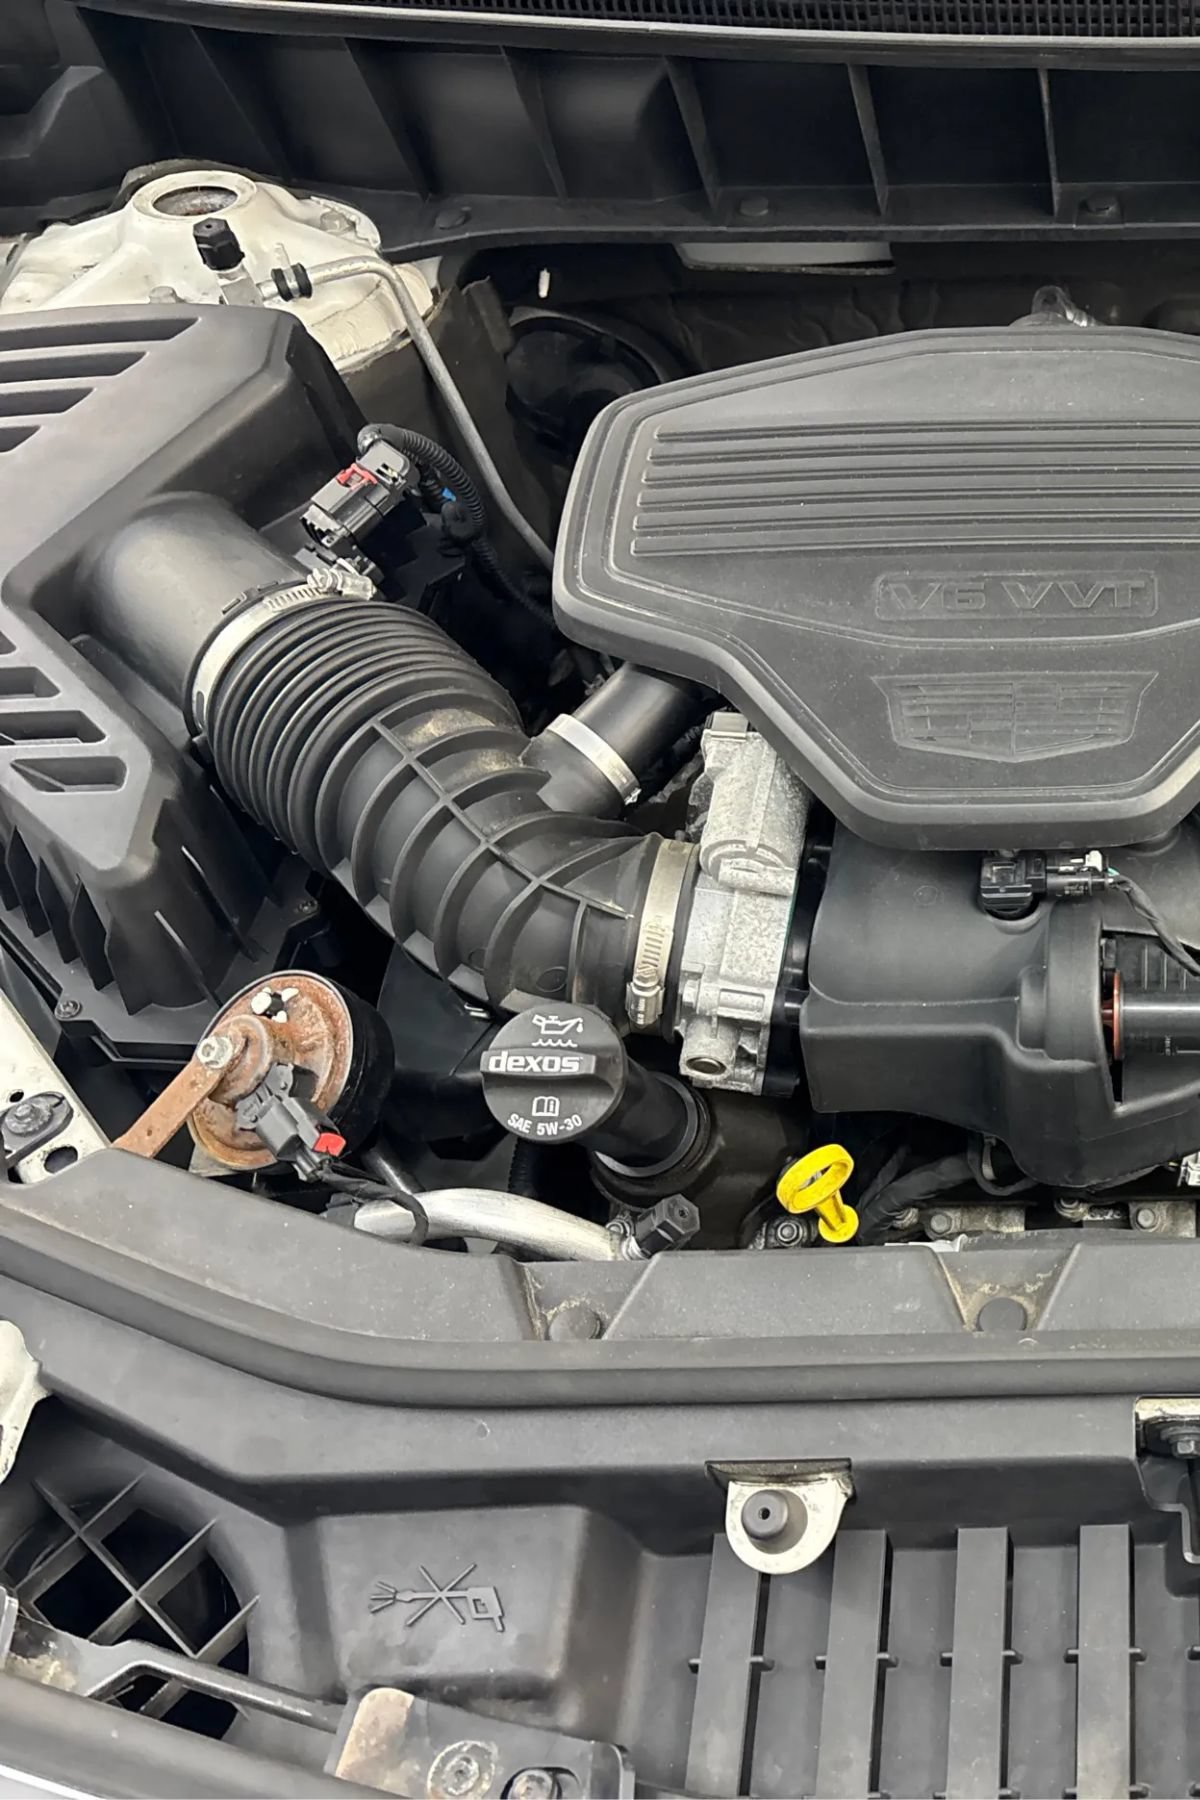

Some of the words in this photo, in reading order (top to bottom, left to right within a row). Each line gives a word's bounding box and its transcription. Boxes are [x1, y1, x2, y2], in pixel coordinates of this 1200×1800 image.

[888, 581, 986, 610] V6
[1000, 580, 1145, 609] VVT
[488, 1051, 580, 1073] dexos
[507, 1113, 533, 1134] SAE
[536, 1114, 583, 1136] 5W-30
